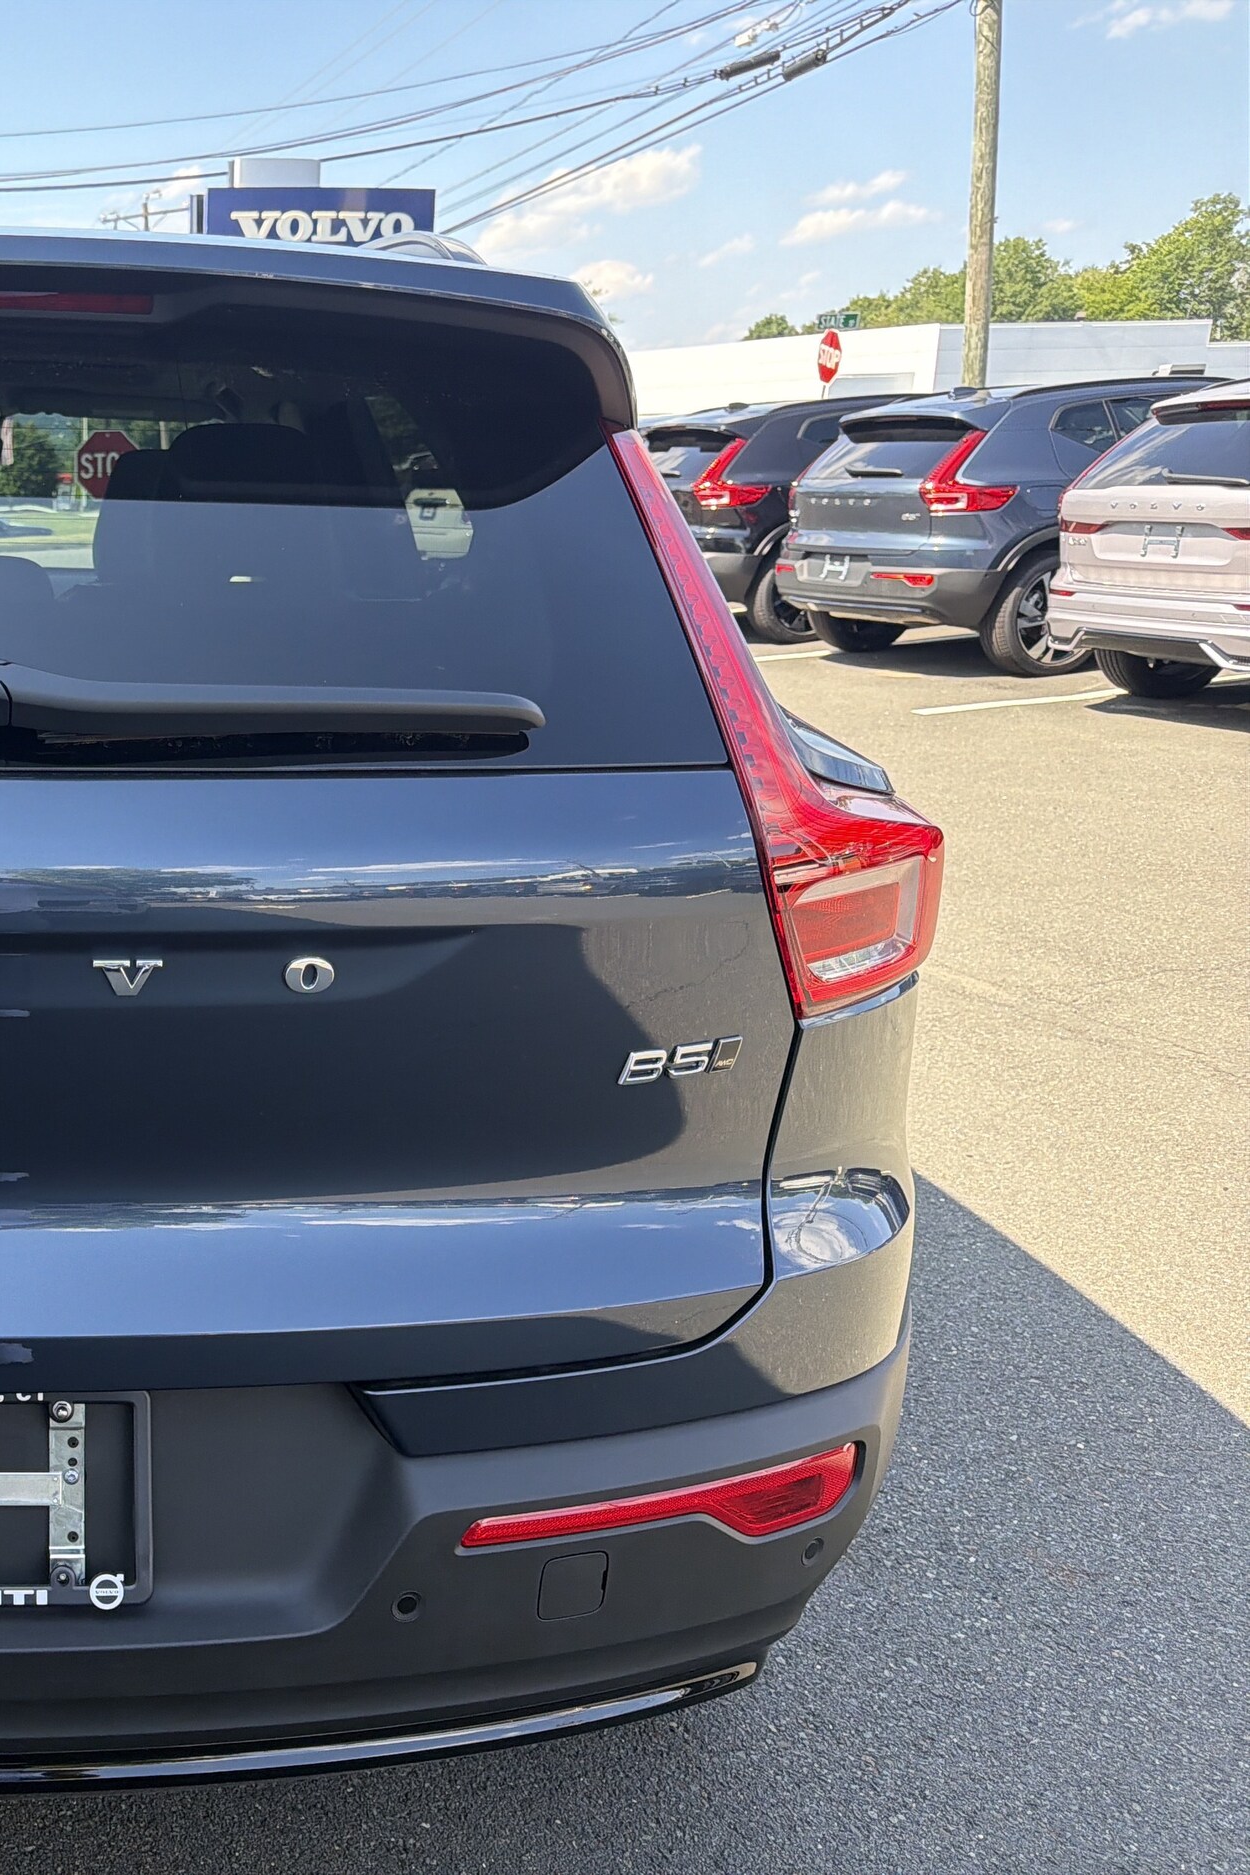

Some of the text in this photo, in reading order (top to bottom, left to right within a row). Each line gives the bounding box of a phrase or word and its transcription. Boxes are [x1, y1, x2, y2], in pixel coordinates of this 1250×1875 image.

[230, 210, 415, 242] VOLVO
[818, 343, 841, 370] STOP
[80, 452, 120, 479] STO
[1110, 502, 1206, 511] VOLVO
[617, 1041, 713, 1085] B5
